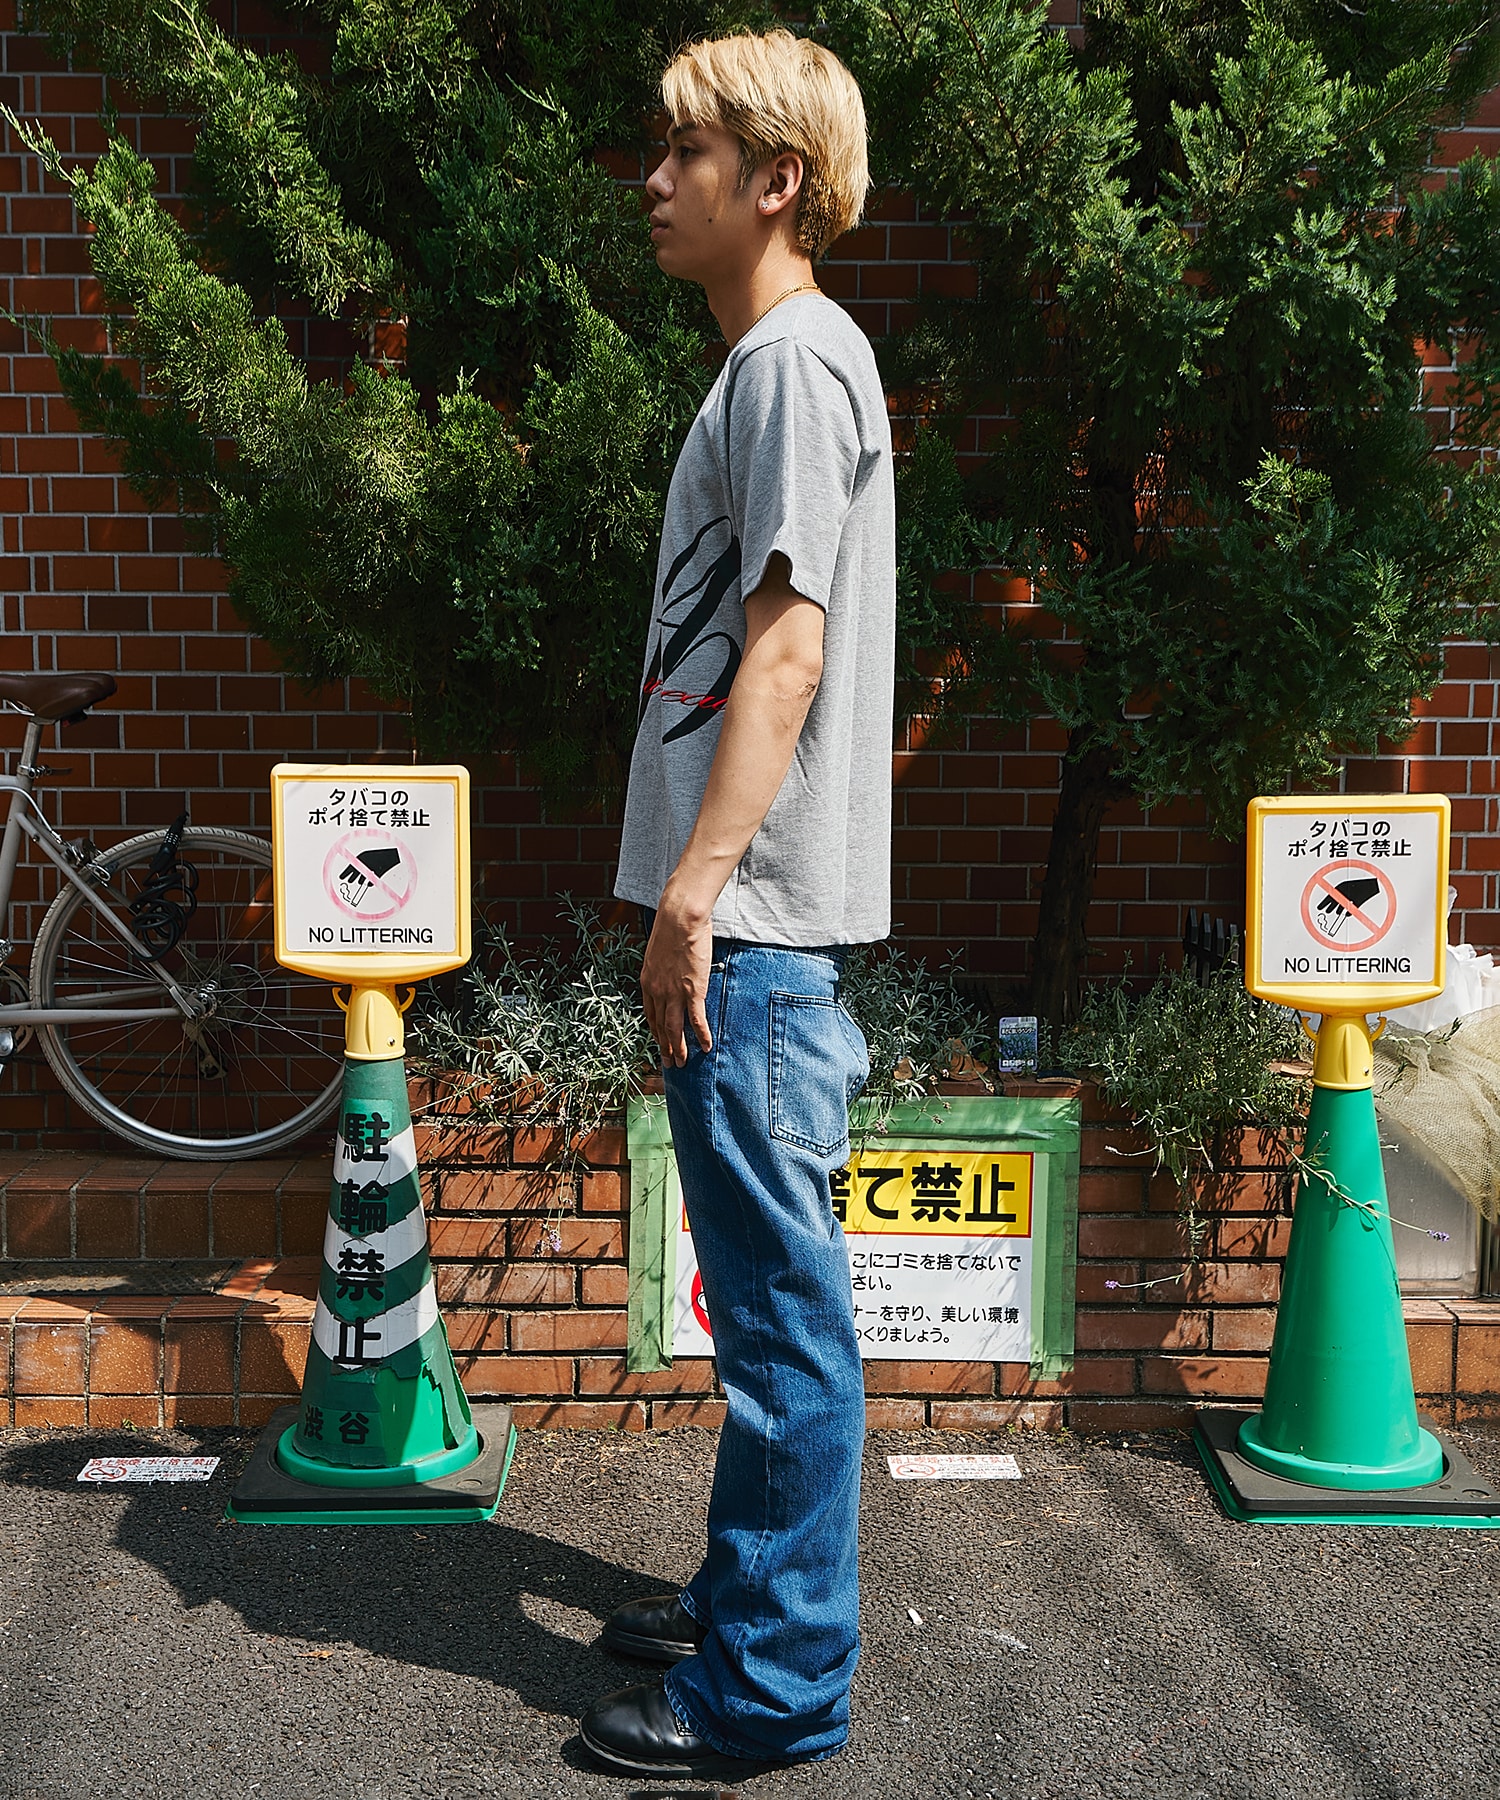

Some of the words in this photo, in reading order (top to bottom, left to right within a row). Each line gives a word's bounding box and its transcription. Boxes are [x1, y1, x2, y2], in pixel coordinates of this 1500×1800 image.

[329, 787, 409, 806] タバコの
[308, 806, 431, 828] ポイ捨て禁止
[1309, 819, 1391, 838] タバコの
[1287, 838, 1412, 858] ポイ捨て禁止
[308, 927, 334, 943] NO
[340, 927, 433, 944] LITTERING
[1284, 957, 1310, 973] NO
[1316, 957, 1411, 973] LITTERING
[333, 1112, 390, 1366] 駐輪禁止
[852, 1252, 1022, 1272] こにゴミを捨てないで
[851, 1274, 892, 1291] さい。
[303, 1404, 369, 1445] 渋谷
